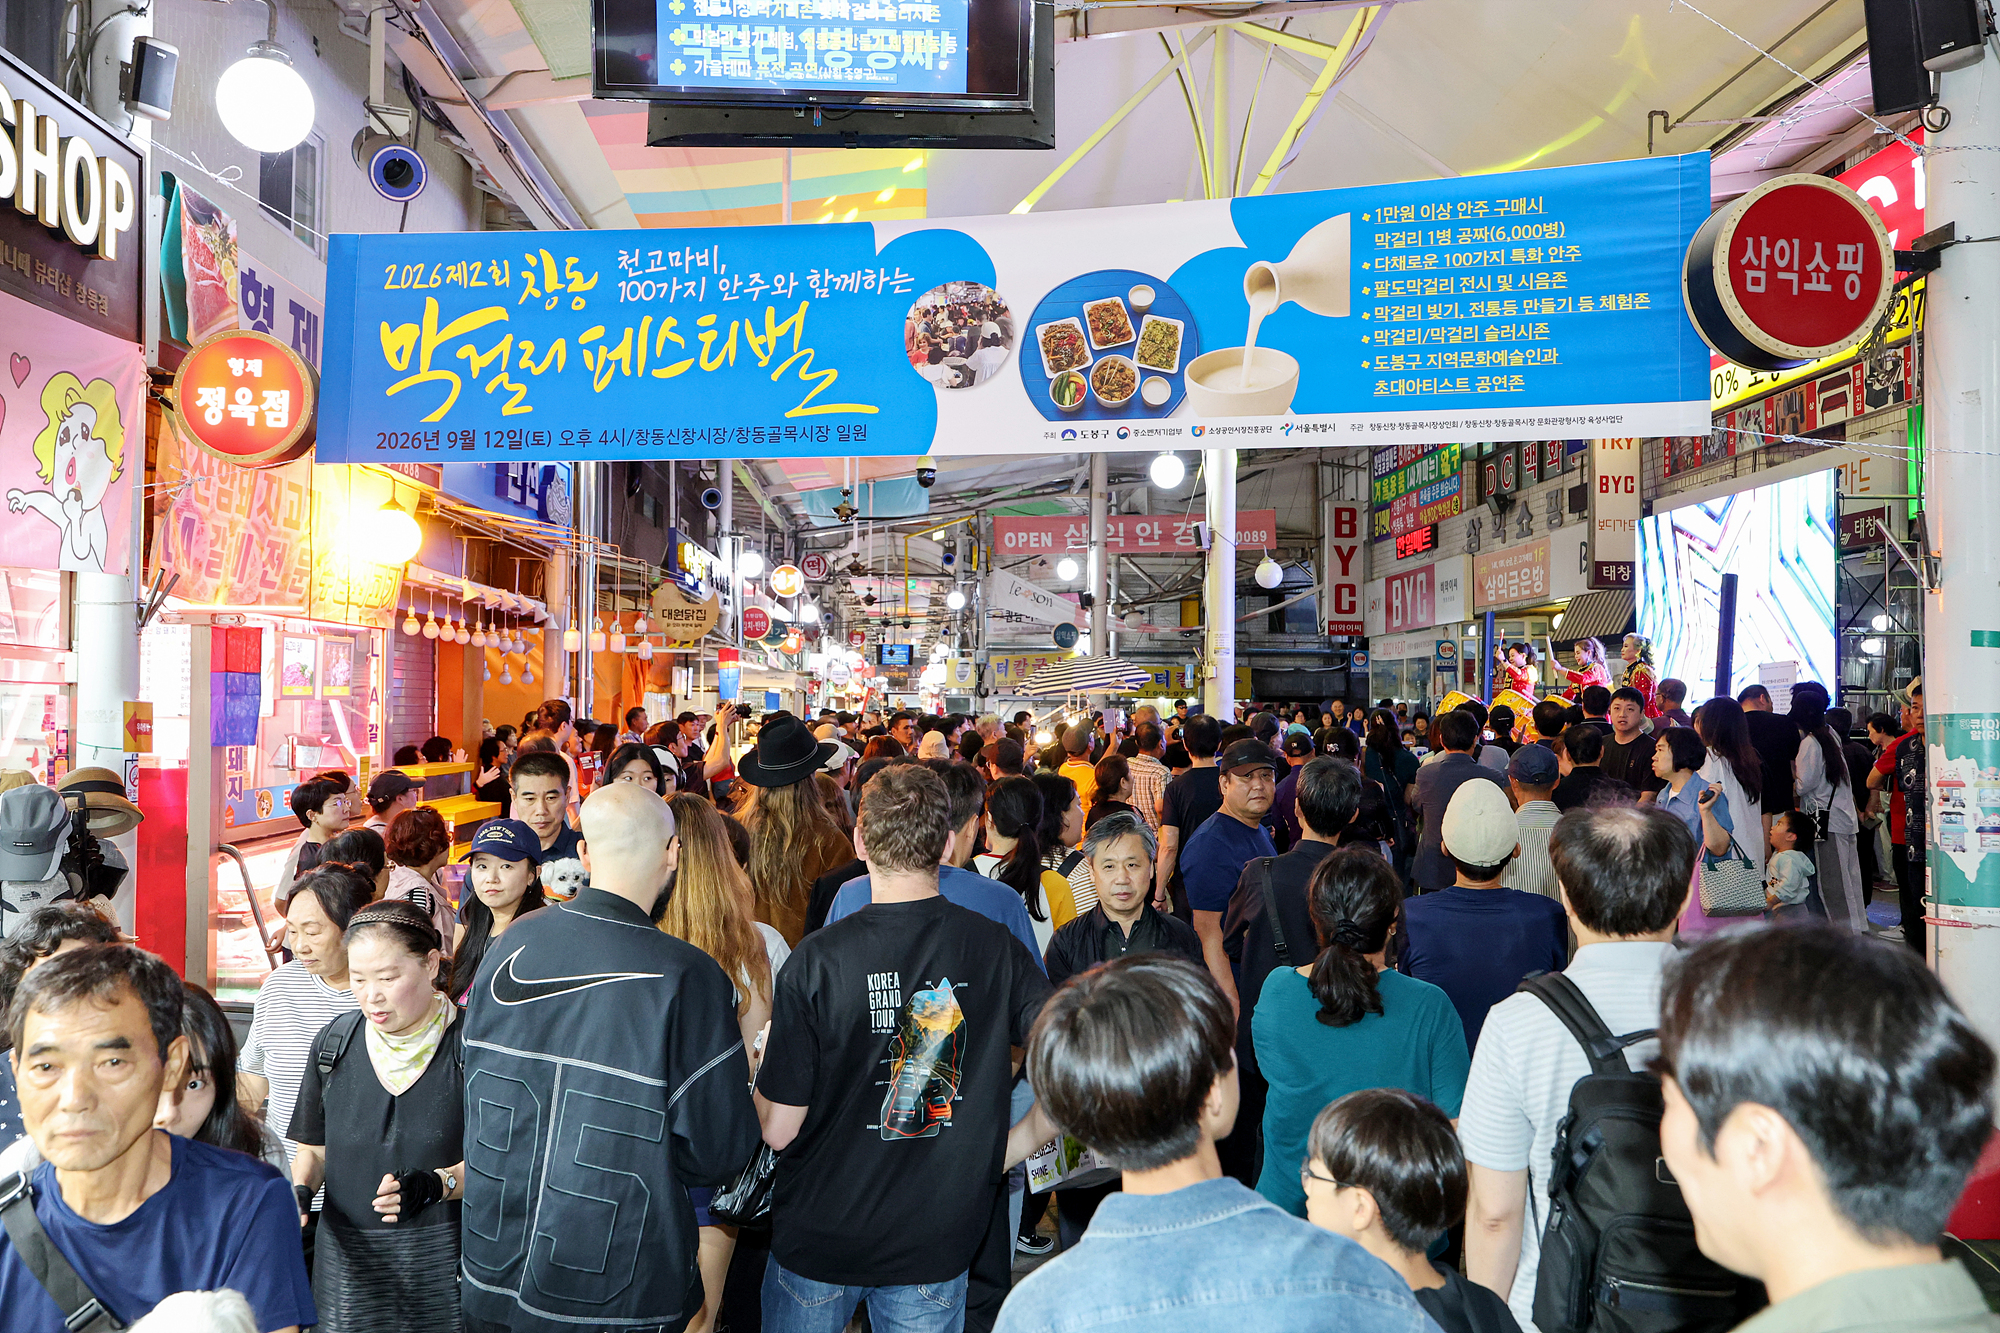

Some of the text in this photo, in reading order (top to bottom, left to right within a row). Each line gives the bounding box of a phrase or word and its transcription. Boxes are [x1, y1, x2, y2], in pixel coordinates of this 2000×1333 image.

[1375, 196, 1543, 223] 1만원 이상 안주 구매시
[1375, 221, 1566, 249] 막걸리 1병 공짜(6,000병)
[617, 245, 727, 277] 천고마비,
[1375, 244, 1582, 272] 다채로운 100가지 특화 안주
[1740, 236, 1864, 301] 삼익쇼핑
[35, 259, 109, 317] 뷰티샵 창동점
[518, 248, 599, 311] 창동
[618, 267, 915, 303] 100가지 안주와 함께하는
[1374, 270, 1568, 298] 팔도막걸리 전시 및 시음존
[1374, 292, 1650, 322] 막걸리 빚기, 전통등 만들기 등 체험존
[1374, 321, 1550, 345] 막걸리/막걸리 슬러시존
[227, 357, 263, 378] 형제
[380, 296, 880, 423] 막걸리 페스티벌
[1374, 347, 1559, 371] 도봉구 지역문화예술인과
[1374, 374, 1525, 396] 초대아티스트 공연존
[195, 386, 290, 428] 정육점
[376, 423, 867, 451] 2026년 9월 12일(토) 오후 4시/창동신창시장/창동골목시장 일원
[1080, 429, 1110, 440] 도봉구
[1133, 427, 1183, 438] 중소벤처기업부
[1208, 425, 1273, 435] 소상공인시장진흥공단
[1295, 422, 1336, 434] 서울특별시
[1350, 423, 1364, 432] 주관
[1537, 416, 1586, 426] 문화관광형시장
[1588, 415, 1623, 425] 육성사업단
[1486, 440, 1575, 496] DC 백화
[1374, 470, 1405, 502] 겨울용품
[1600, 475, 1634, 494] BYC
[1004, 532, 1052, 548] OPEN
[1853, 516, 1877, 539] 태창
[806, 558, 821, 575] 떡
[1333, 507, 1358, 615] BYC
[1603, 564, 1632, 580] 태창
[1485, 565, 1545, 601] 삼익금은방
[1392, 572, 1427, 628] BYC
[662, 608, 707, 621] 대원닭집
[1330, 624, 1362, 633] 비와이씨
[867, 971, 900, 992] KOREA
[868, 989, 902, 1010] GRAND
[870, 1009, 895, 1029] TOUR
[1031, 1164, 1048, 1180] SHINE
